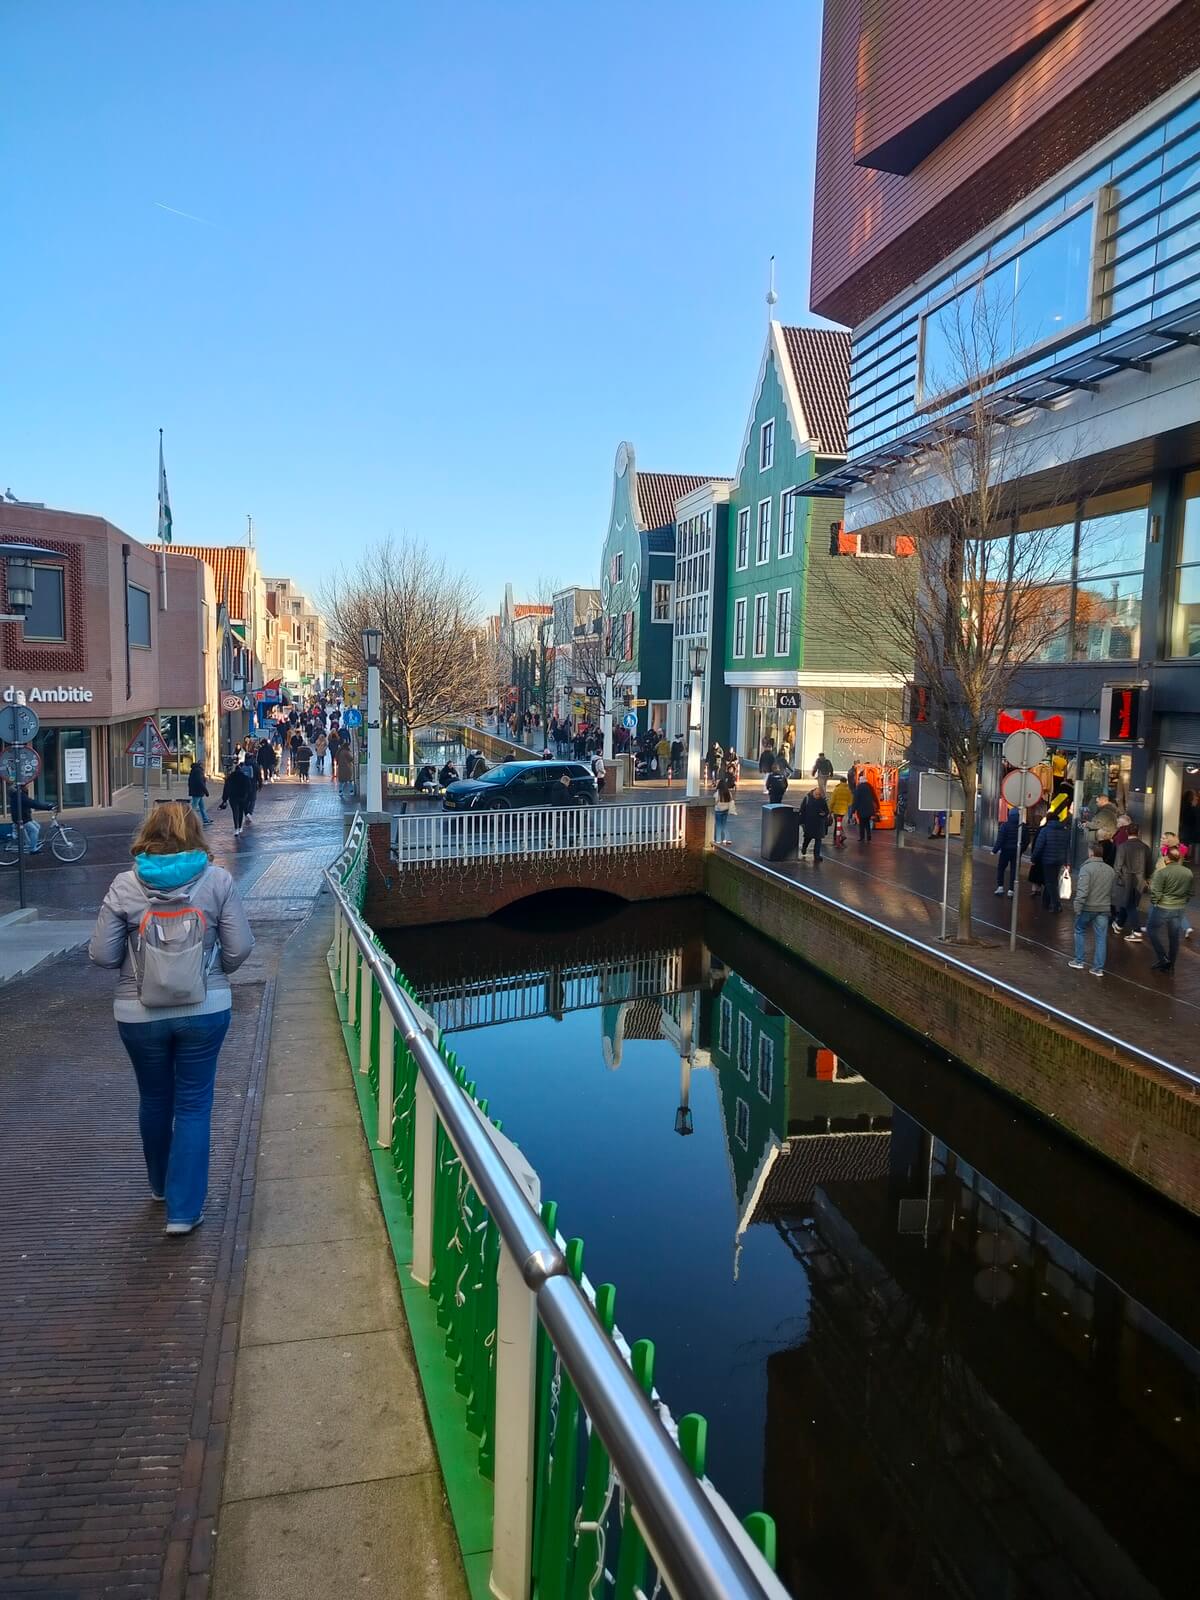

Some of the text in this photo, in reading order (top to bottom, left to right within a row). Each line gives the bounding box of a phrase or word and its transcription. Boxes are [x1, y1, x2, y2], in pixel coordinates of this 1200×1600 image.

[3, 685, 93, 702] de Ambitie
[837, 724, 860, 734] Word
[837, 735, 873, 745] member!
